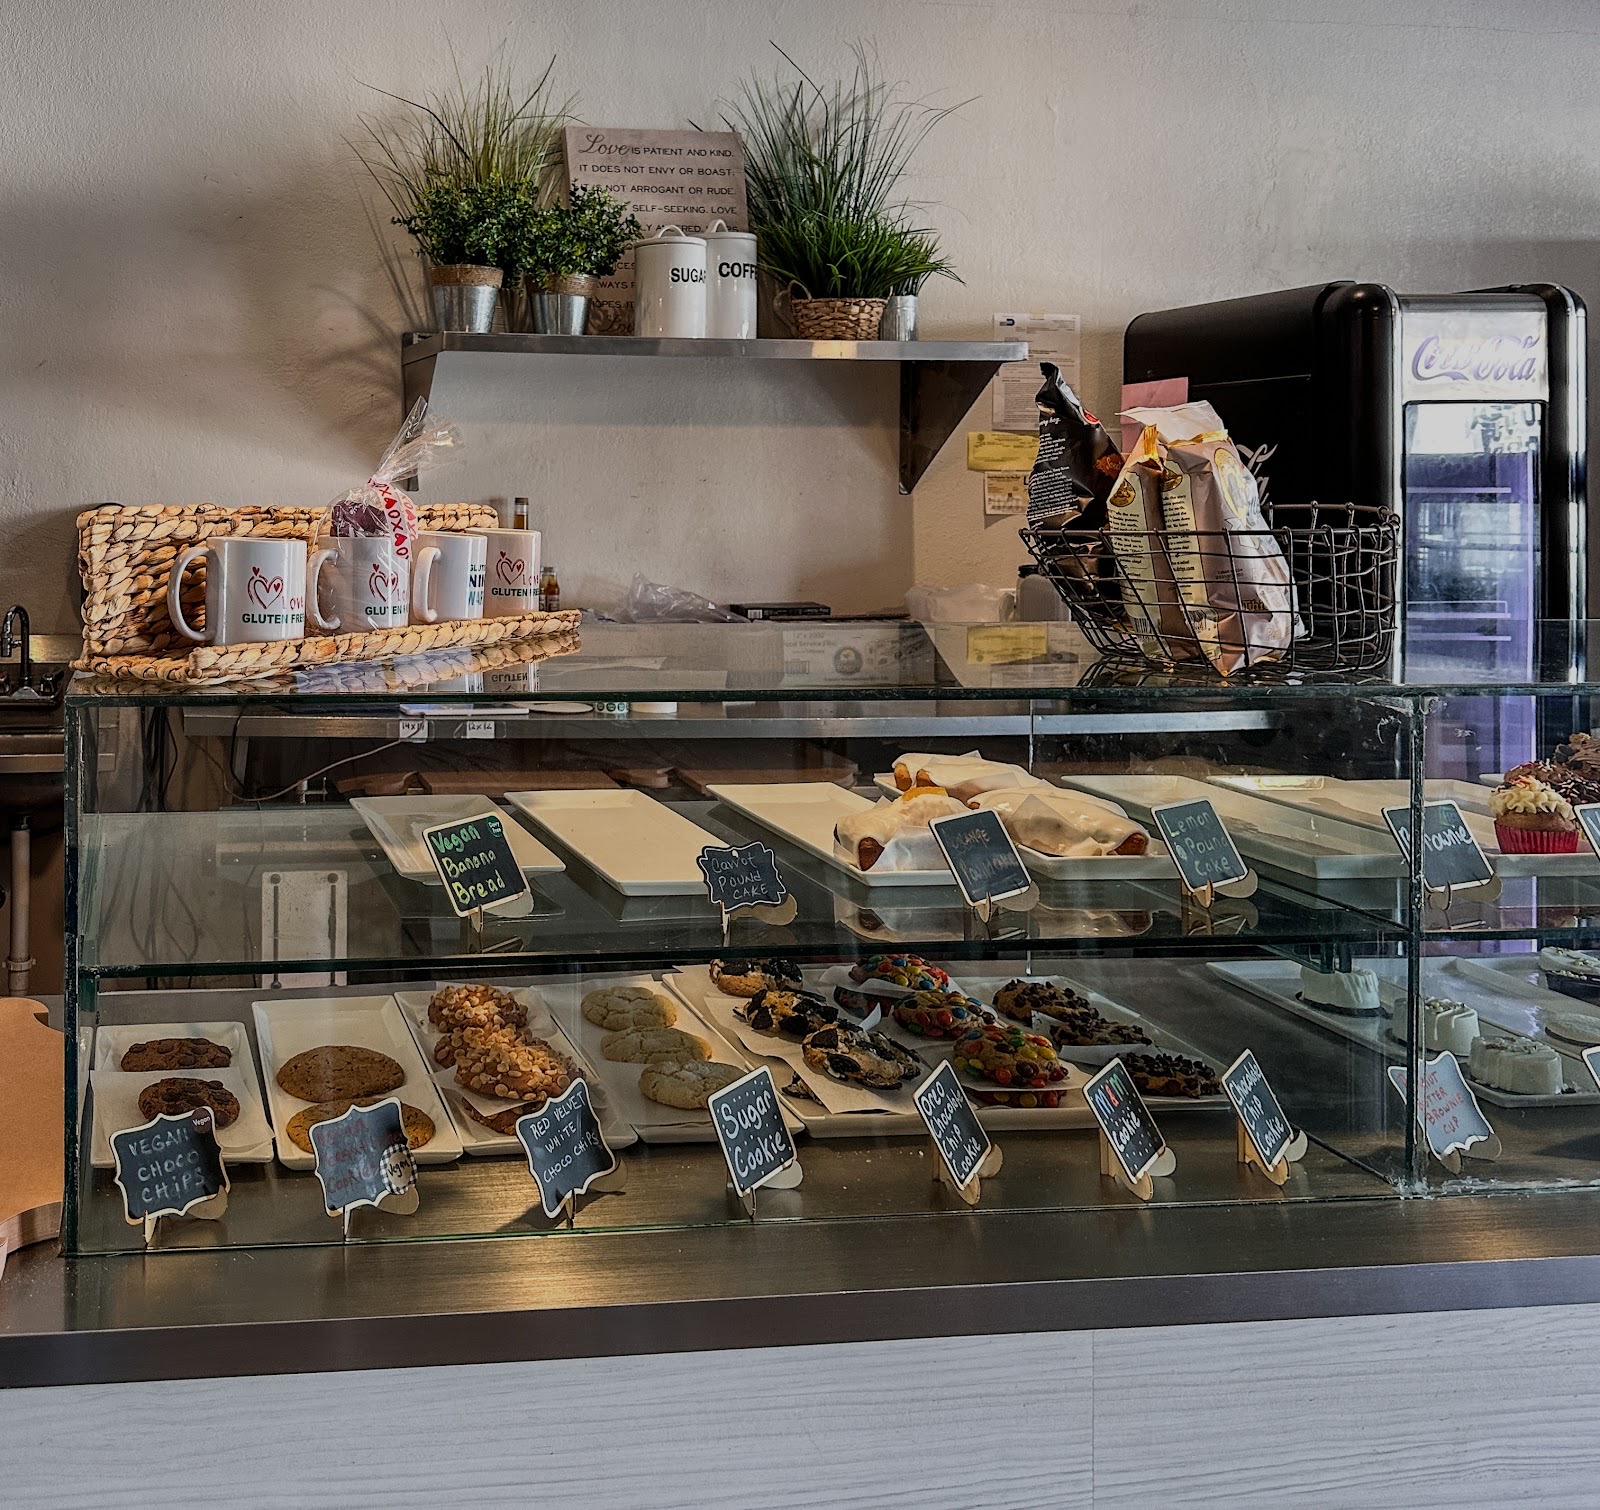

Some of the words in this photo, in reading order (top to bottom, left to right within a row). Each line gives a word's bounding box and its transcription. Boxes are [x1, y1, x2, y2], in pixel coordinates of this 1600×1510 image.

[578, 134, 630, 155] Love
[631, 147, 641, 155] IS
[643, 147, 683, 156] PATIENT
[709, 149, 734, 157] KIND.
[579, 164, 588, 172] IT
[592, 165, 621, 173] DOES
[649, 166, 675, 174] ENVY
[679, 167, 693, 175] OR
[697, 168, 735, 176] BOAST.
[605, 184, 626, 192] NOT
[630, 185, 685, 194] ARROGANT
[706, 187, 736, 195] RUDE.
[711, 206, 737, 214] LOVE
[718, 262, 757, 280] COFF
[491, 587, 528, 597] GLUTEN
[242, 613, 289, 624] GLUTEN
[1160, 811, 1213, 838] Lemon
[430, 825, 480, 854] Vegan
[1184, 836, 1229, 856] Pound
[441, 849, 497, 878] Banana
[1194, 856, 1231, 876] Cake
[452, 869, 506, 905] Bread
[733, 882, 768, 900] CAKE
[920, 1081, 945, 1117] Oreo
[929, 1088, 963, 1139] Chocolate
[1243, 1094, 1264, 1131] Chip
[1426, 1092, 1464, 1126] BROWNIE
[192, 1116, 211, 1126] Vegan
[529, 1117, 550, 1140] RED
[553, 1091, 586, 1121] VELVET
[720, 1090, 771, 1139] Sugar
[1443, 1115, 1459, 1135] CUP
[128, 1127, 189, 1157] VEGAN
[942, 1123, 963, 1160] Chip
[1112, 1111, 1141, 1153] Cookie
[1256, 1116, 1285, 1157] Cookie
[137, 1149, 199, 1182] CHOCO
[387, 1159, 411, 1178] Vegan
[543, 1154, 572, 1183] CHOCO
[735, 1131, 786, 1178] Cookie
[952, 1136, 981, 1180] Cookie
